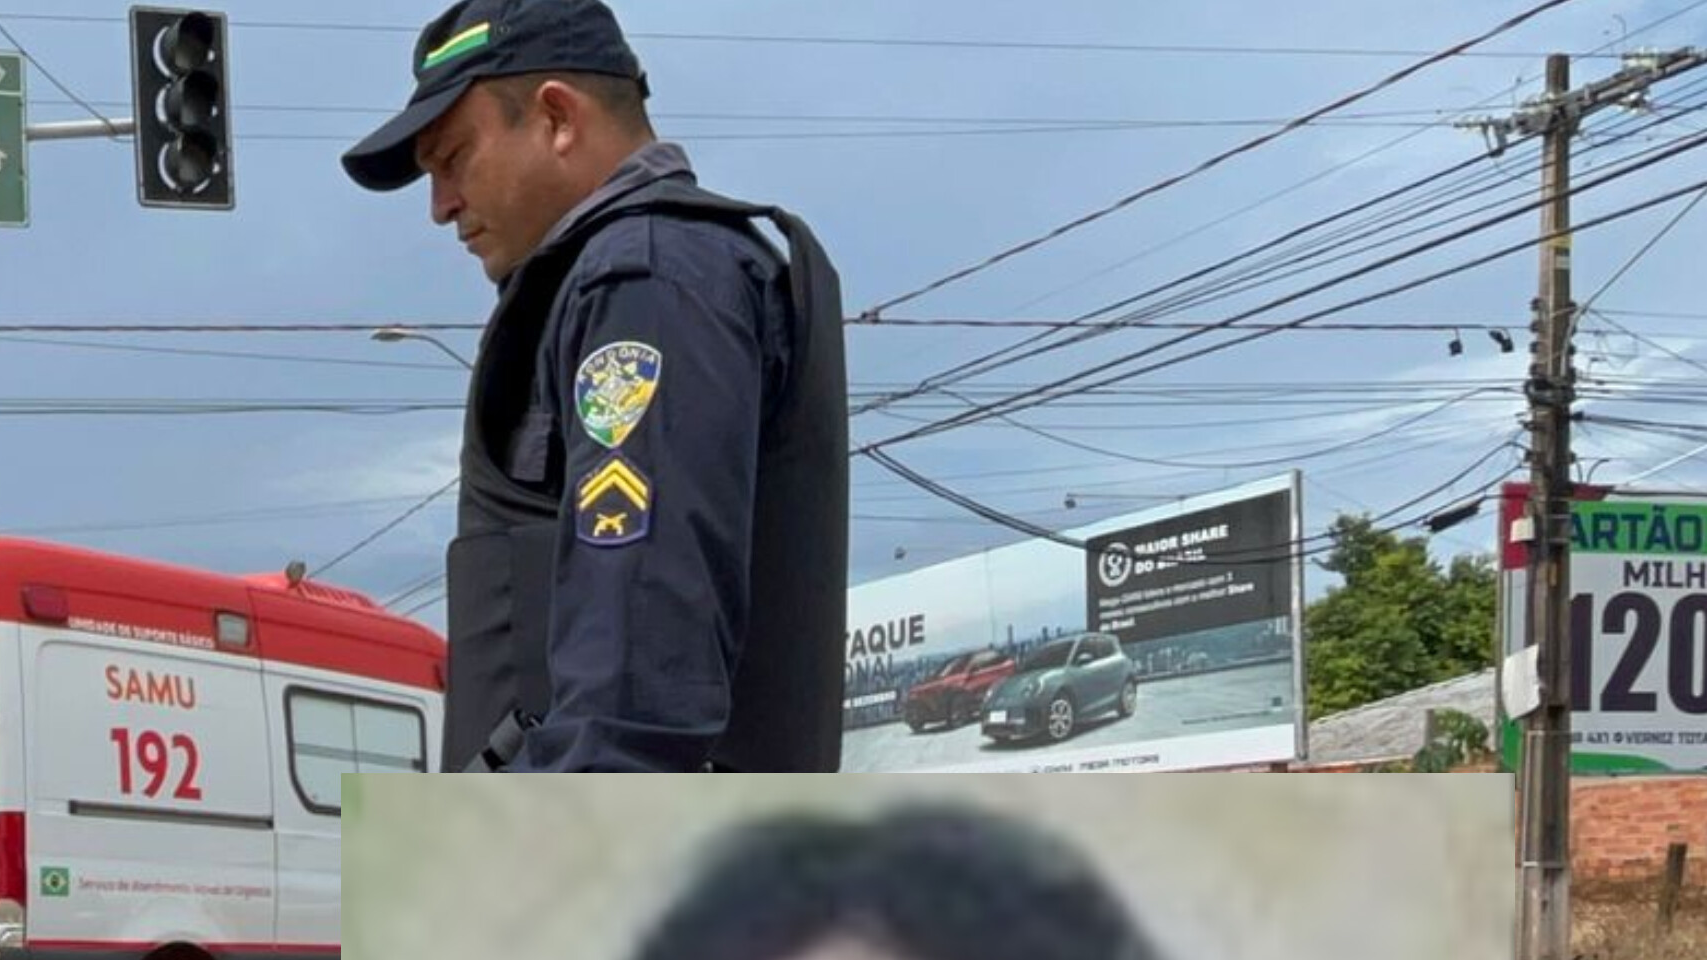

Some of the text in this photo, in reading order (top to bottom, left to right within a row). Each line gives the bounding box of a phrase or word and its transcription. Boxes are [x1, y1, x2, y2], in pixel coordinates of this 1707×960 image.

[1181, 524, 1230, 546] SHARE
[1134, 560, 1155, 575] DO
[1622, 560, 1706, 589] MILH
[105, 664, 195, 710] SAMU
[110, 727, 202, 801] 192
